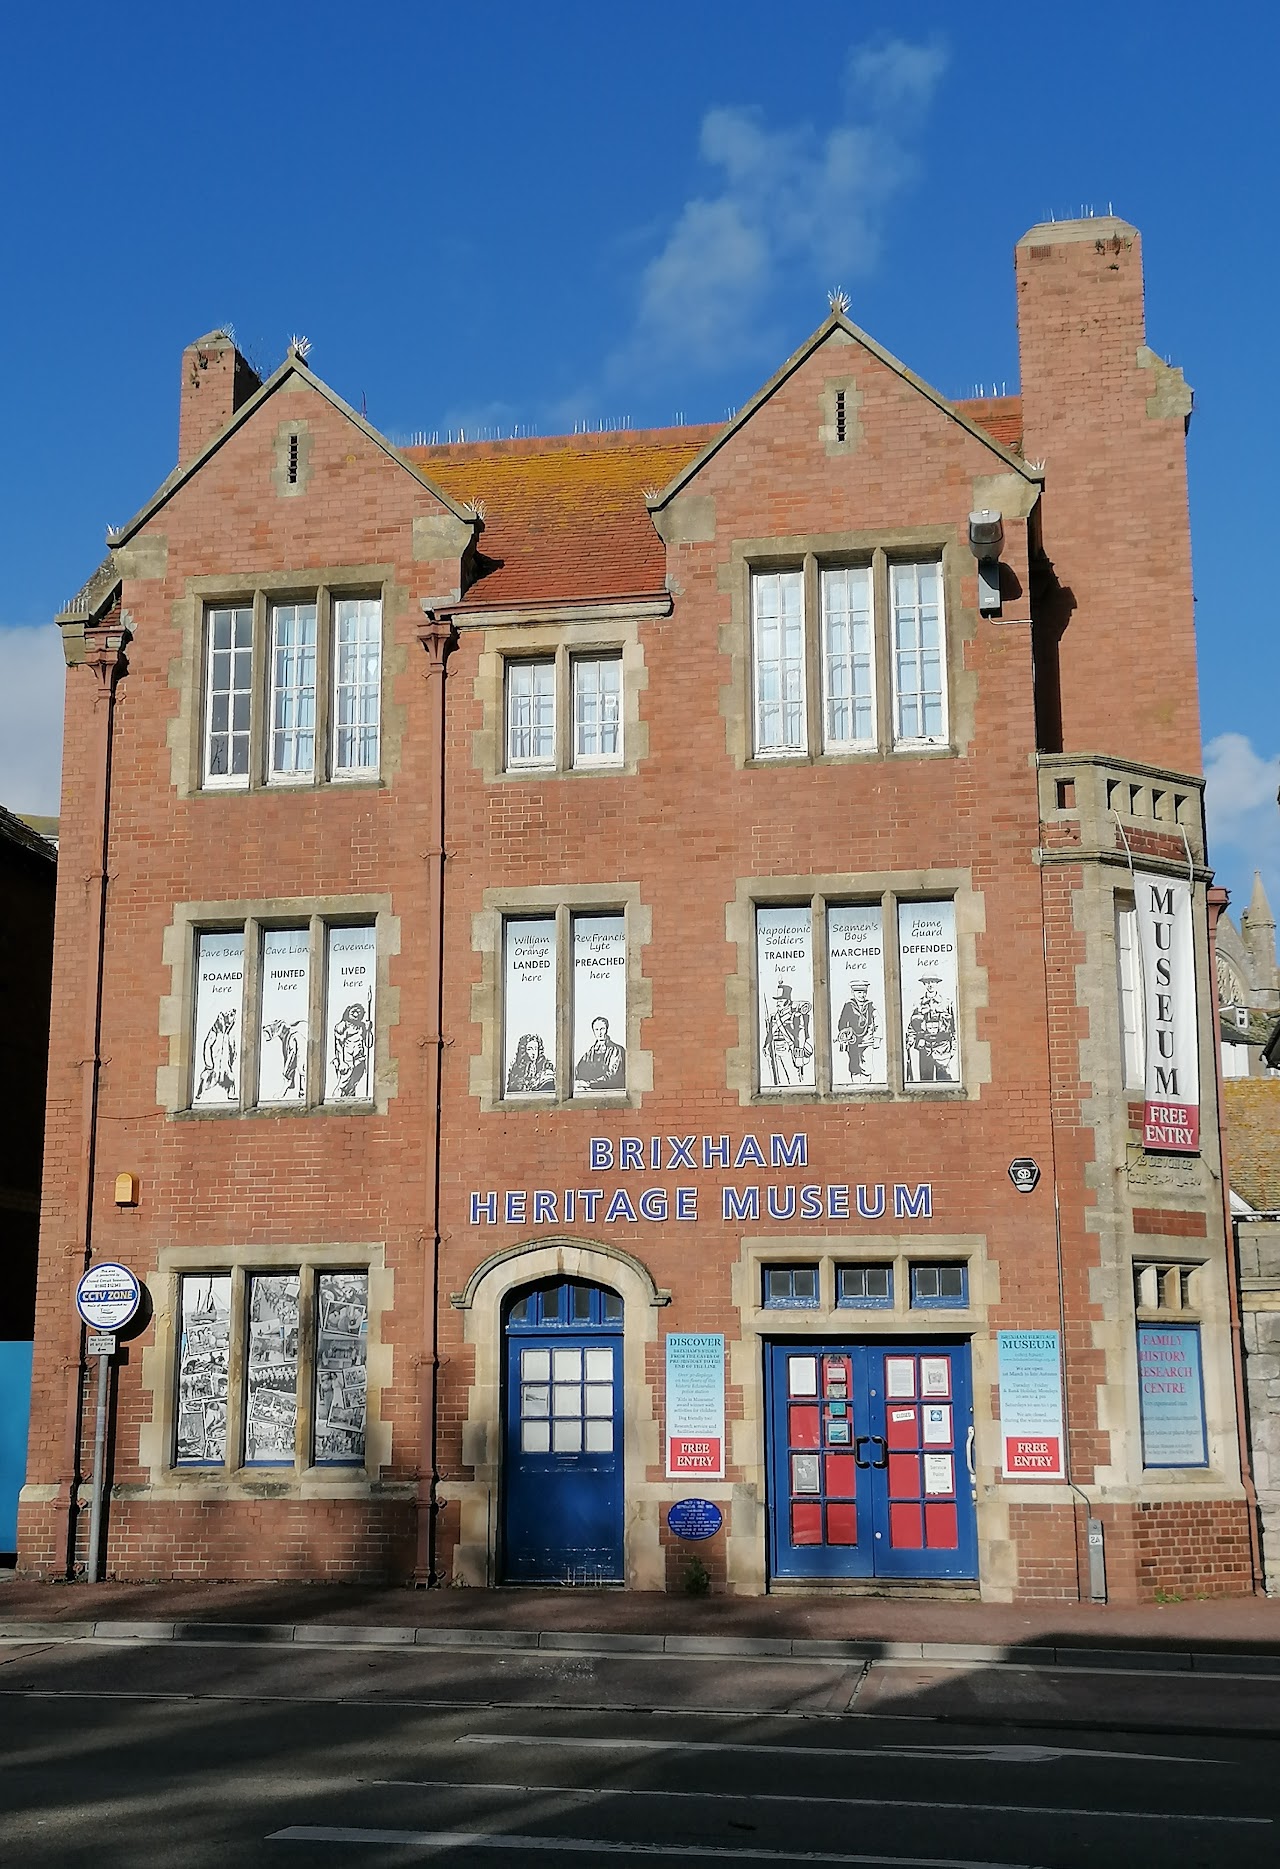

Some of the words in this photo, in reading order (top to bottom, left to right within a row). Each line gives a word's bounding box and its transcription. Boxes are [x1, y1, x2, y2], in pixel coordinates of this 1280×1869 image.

[832, 922, 878, 933] Seamen's
[912, 920, 941, 928] Home
[758, 924, 811, 937] Napoleonic
[911, 928, 942, 938] Guard
[514, 935, 550, 944] William
[592, 932, 626, 942] Francis
[766, 936, 804, 946] Soldiers
[844, 932, 867, 942] Boys
[266, 946, 286, 955] Cave
[289, 945, 310, 954] Lion
[333, 943, 375, 952] Cavemen
[590, 942, 610, 952] Lyte
[902, 944, 953, 954] DEFENDED
[200, 950, 220, 958] Cave
[224, 949, 244, 957] Bear
[514, 947, 549, 958] Orange
[764, 951, 805, 960] TRAINED
[831, 948, 881, 958] MARCHED
[514, 960, 550, 970] LANDED
[576, 957, 625, 967] PREACHED
[846, 961, 867, 970] here
[917, 958, 939, 967] here
[341, 966, 366, 975] LIVED
[774, 964, 796, 972] here
[202, 972, 242, 982] ROAMED
[270, 970, 306, 979] HUNTED
[522, 974, 542, 982] here
[590, 971, 610, 980] here
[278, 982, 298, 991] here
[343, 979, 364, 988] here
[212, 985, 232, 994] here
[1148, 884, 1180, 1096] MUSEUM
[1150, 1106, 1188, 1126] FREE
[1145, 1124, 1194, 1145] ENTRY
[590, 1133, 809, 1170] BRIXHAM
[470, 1187, 699, 1224] HERITAGE
[722, 1184, 933, 1220] MUSEUM
[82, 1292, 106, 1301] CCTV
[108, 1290, 133, 1300] ZONE
[670, 1338, 721, 1346] DISCOVER
[1002, 1340, 1055, 1349] MUSEUM
[1143, 1334, 1182, 1346] FAMILY
[1140, 1351, 1186, 1362] HISTORY
[1144, 1382, 1186, 1394] CENTRE
[681, 1443, 710, 1453] FREE
[1017, 1443, 1048, 1453] FREE
[677, 1456, 714, 1466] ENTRY
[1014, 1456, 1052, 1467] ENTRY
